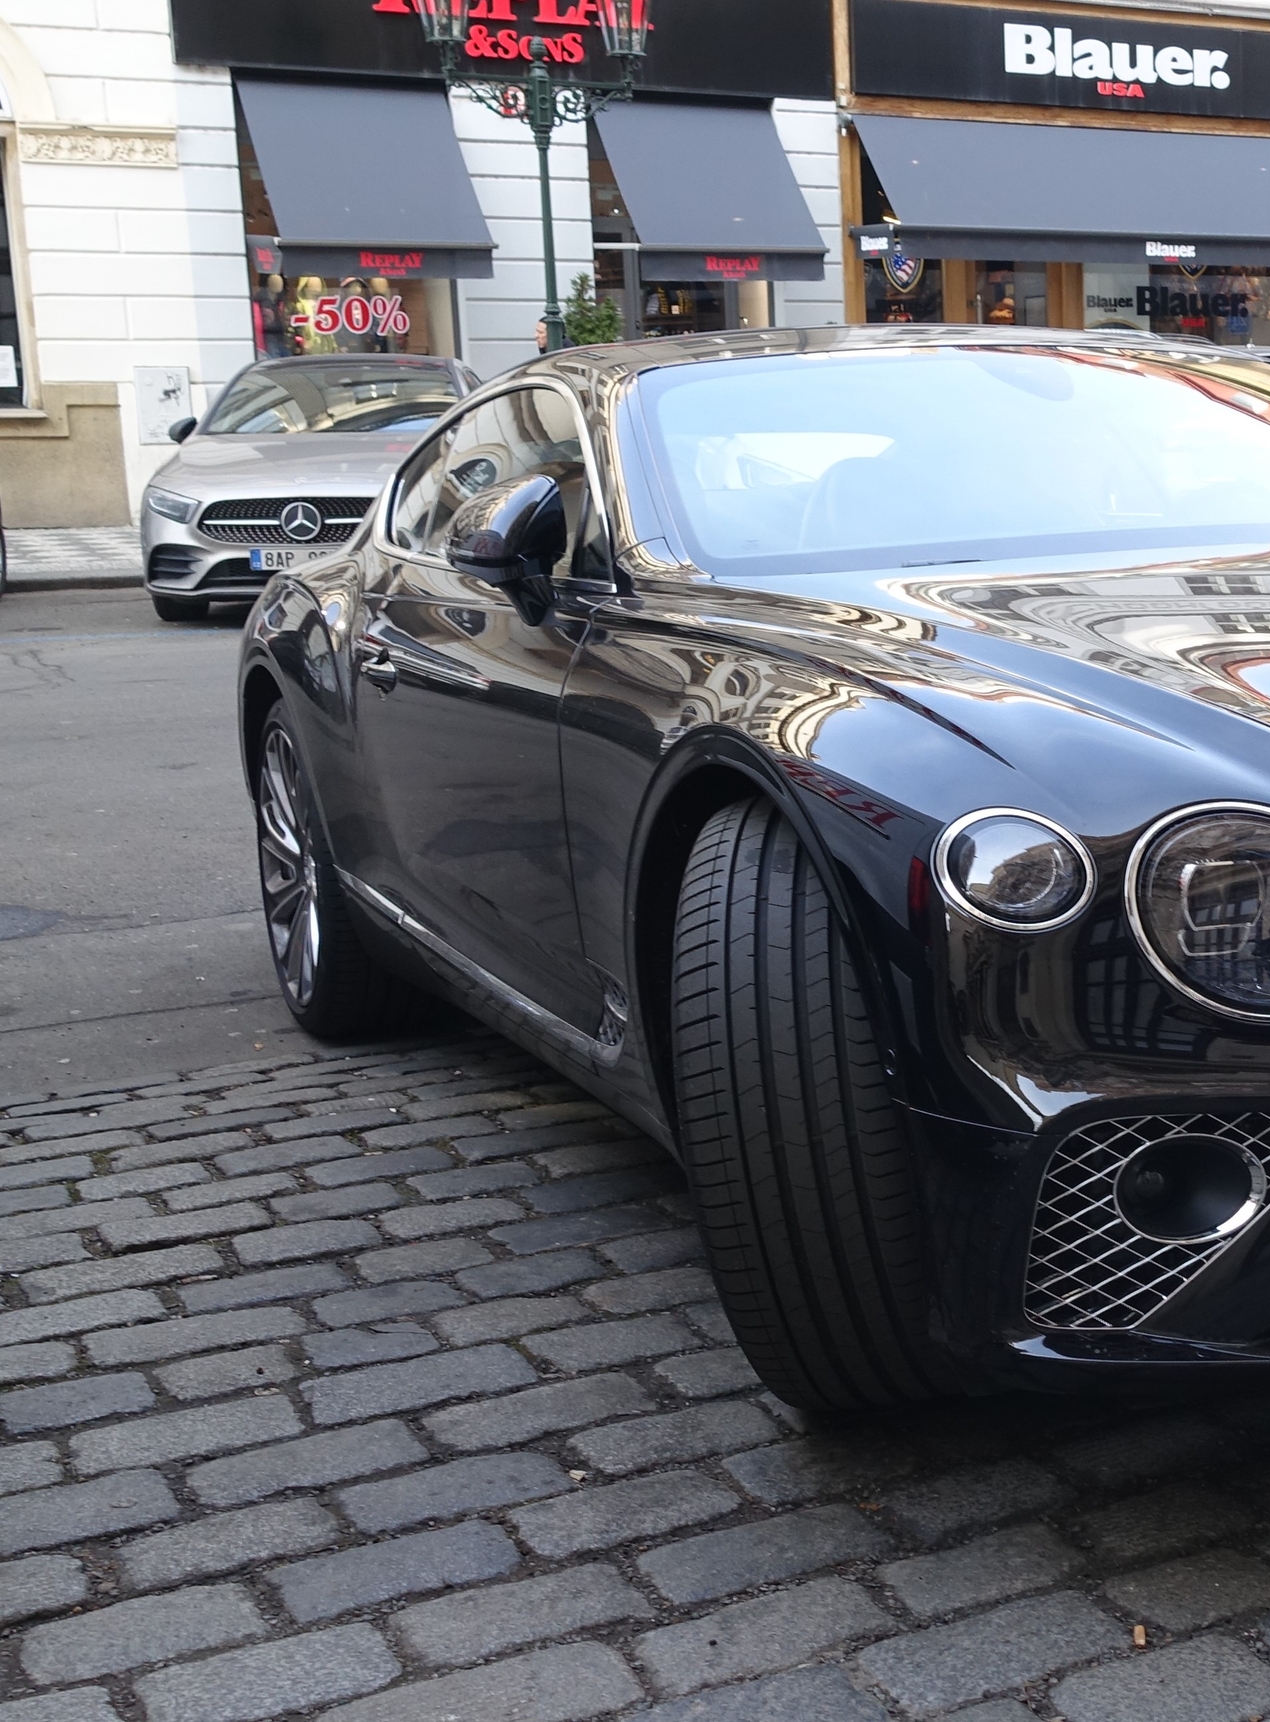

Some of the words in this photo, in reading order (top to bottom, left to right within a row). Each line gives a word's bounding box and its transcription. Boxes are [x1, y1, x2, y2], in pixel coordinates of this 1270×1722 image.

[1003, 22, 1230, 89] Blauer.
[1097, 81, 1145, 98] USA
[359, 252, 424, 268] REPLAY
[705, 256, 761, 271] REPLAY
[291, 296, 410, 336] -50%
[264, 551, 295, 569] 8AP
